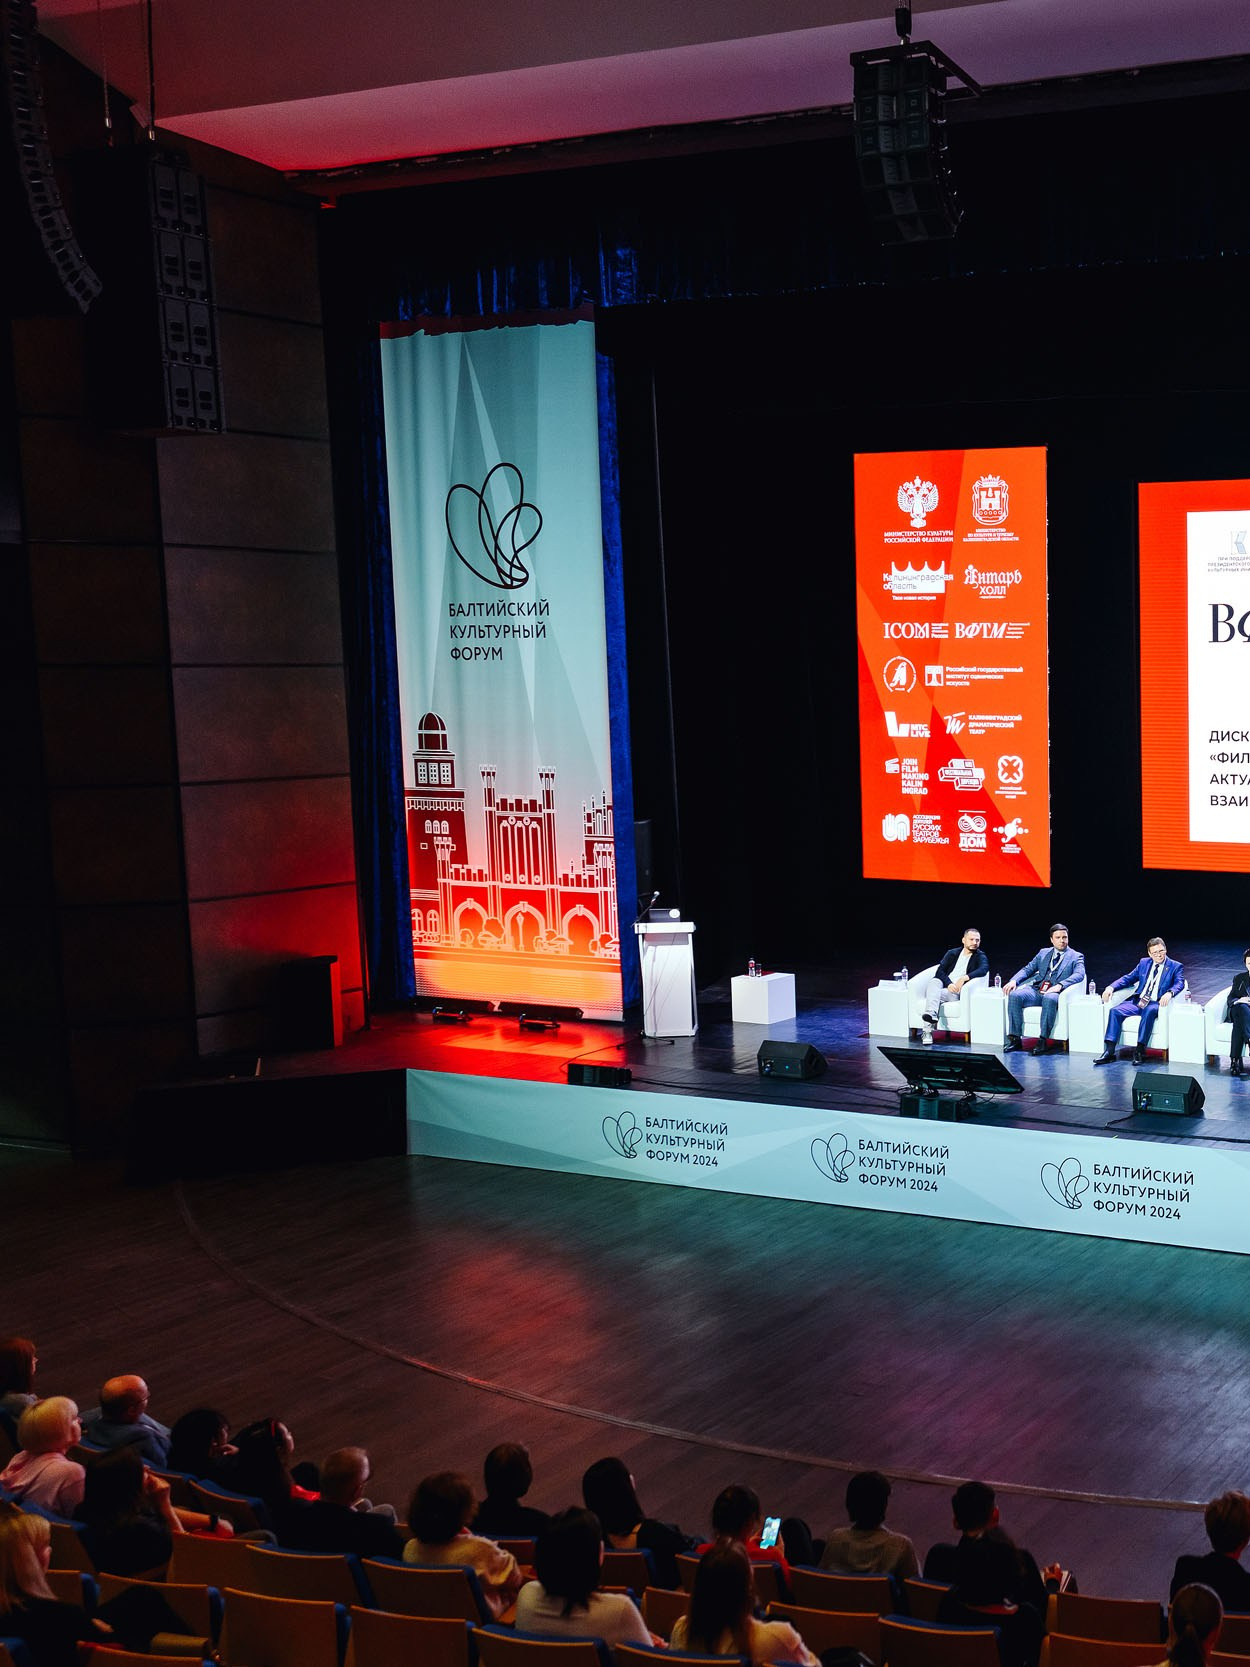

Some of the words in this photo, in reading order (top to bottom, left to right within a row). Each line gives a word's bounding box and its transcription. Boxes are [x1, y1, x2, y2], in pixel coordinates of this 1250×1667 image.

[979, 586, 1006, 595] ХОЛЛ
[448, 598, 550, 617] БАЛТИЙСКИЙ
[449, 621, 547, 639] КУЛЬТУРНЫЙ
[883, 622, 930, 639] ICOM
[954, 622, 1009, 639] ВФТМ
[450, 646, 503, 661] ФОРУМ
[910, 730, 931, 738] LIVE
[901, 765, 919, 773] FILM
[902, 758, 918, 766] JOIN
[901, 772, 929, 780] MAKING
[901, 787, 928, 795] INGRAD
[912, 837, 950, 845] ЗАРУБЕЖЬЯ
[958, 836, 987, 849] ДОМ
[645, 1117, 728, 1136] БАЛТИЙСКИЙ
[646, 1133, 725, 1151] КУЛЬТУРНЫЙ
[858, 1139, 950, 1160] БАЛТИЙСКИЙ
[646, 1150, 690, 1164] ФОРУМ
[692, 1154, 719, 1167] 2024
[858, 1156, 946, 1177] КУЛЬТУРНЫЙ
[858, 1173, 908, 1189] ФОРУМ
[909, 1178, 938, 1193] 2024
[1093, 1163, 1194, 1186] БАЛТИЙСКИЙ
[1092, 1180, 1190, 1203] КУЛЬТУРНЫЙ
[1092, 1199, 1147, 1217] ФОРУМ
[1149, 1205, 1182, 1221] 2024
